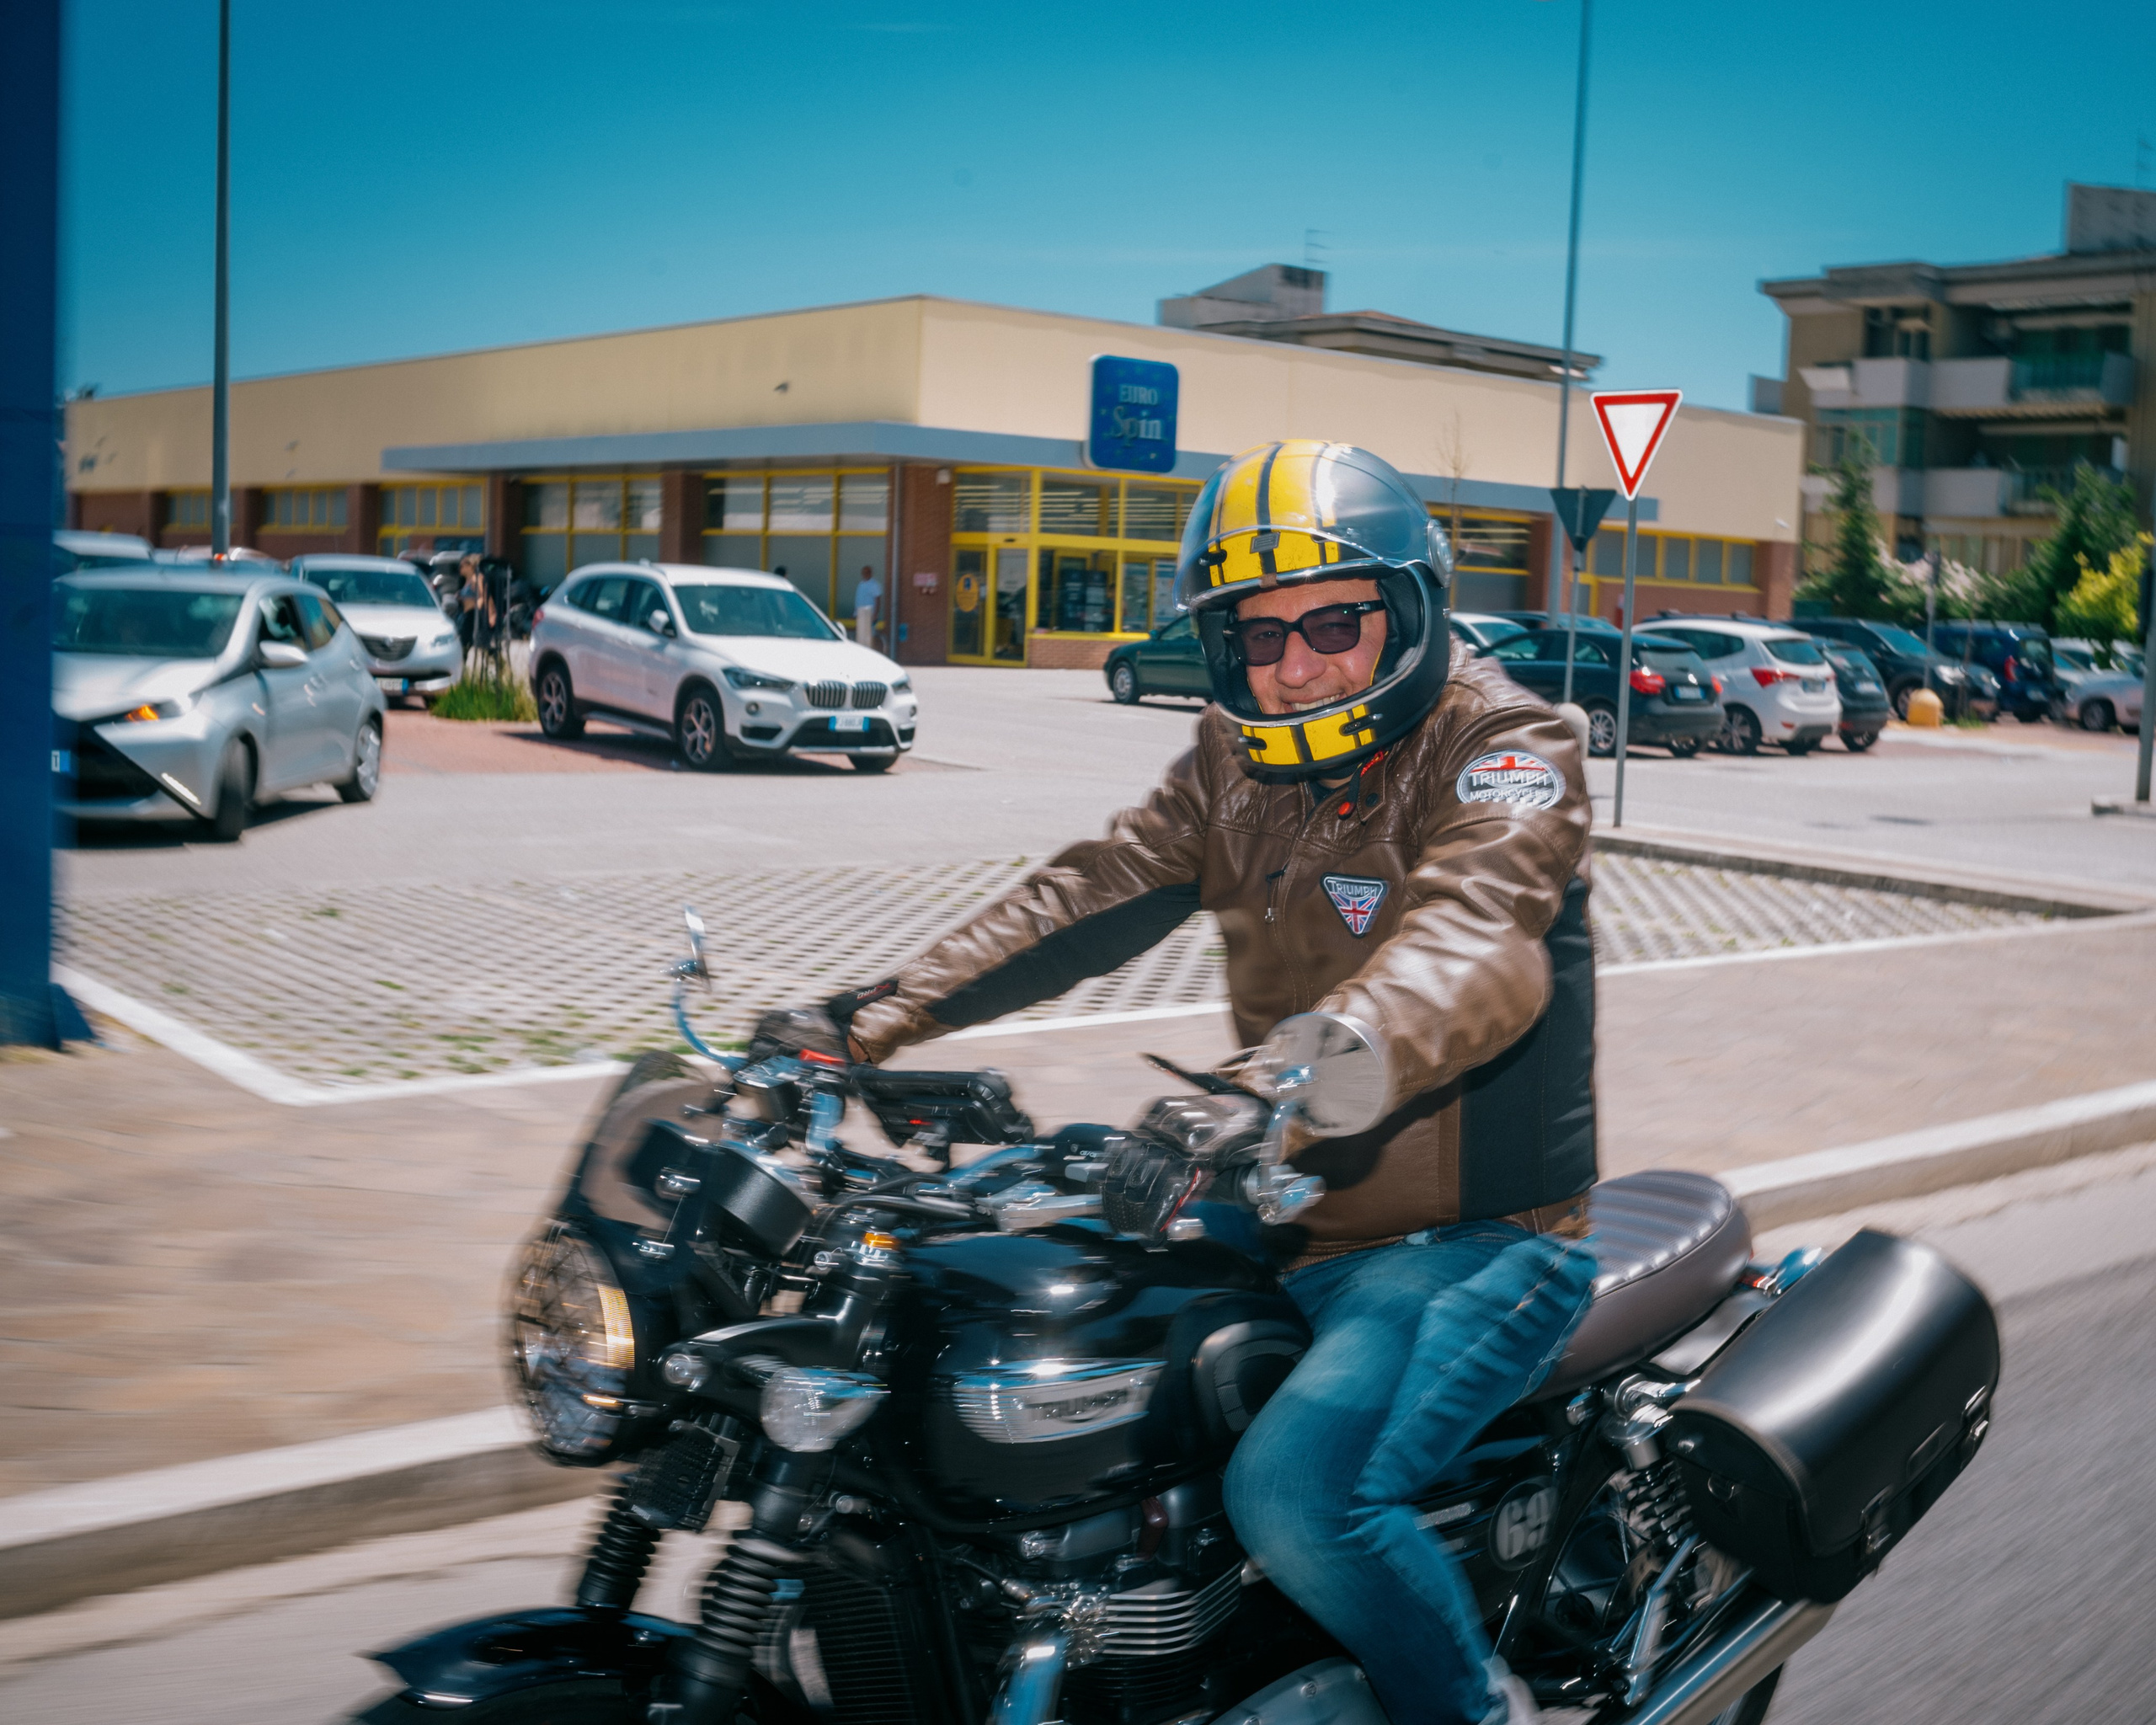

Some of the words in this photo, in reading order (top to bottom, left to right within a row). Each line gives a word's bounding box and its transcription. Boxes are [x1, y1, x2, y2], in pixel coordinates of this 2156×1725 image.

[1119, 384, 1159, 405] EURO
[1111, 405, 1162, 447] Spin
[1468, 770, 1550, 787] TRIUMPH
[1327, 879, 1378, 897] TRIUMPH
[1497, 1487, 1555, 1561] 69
